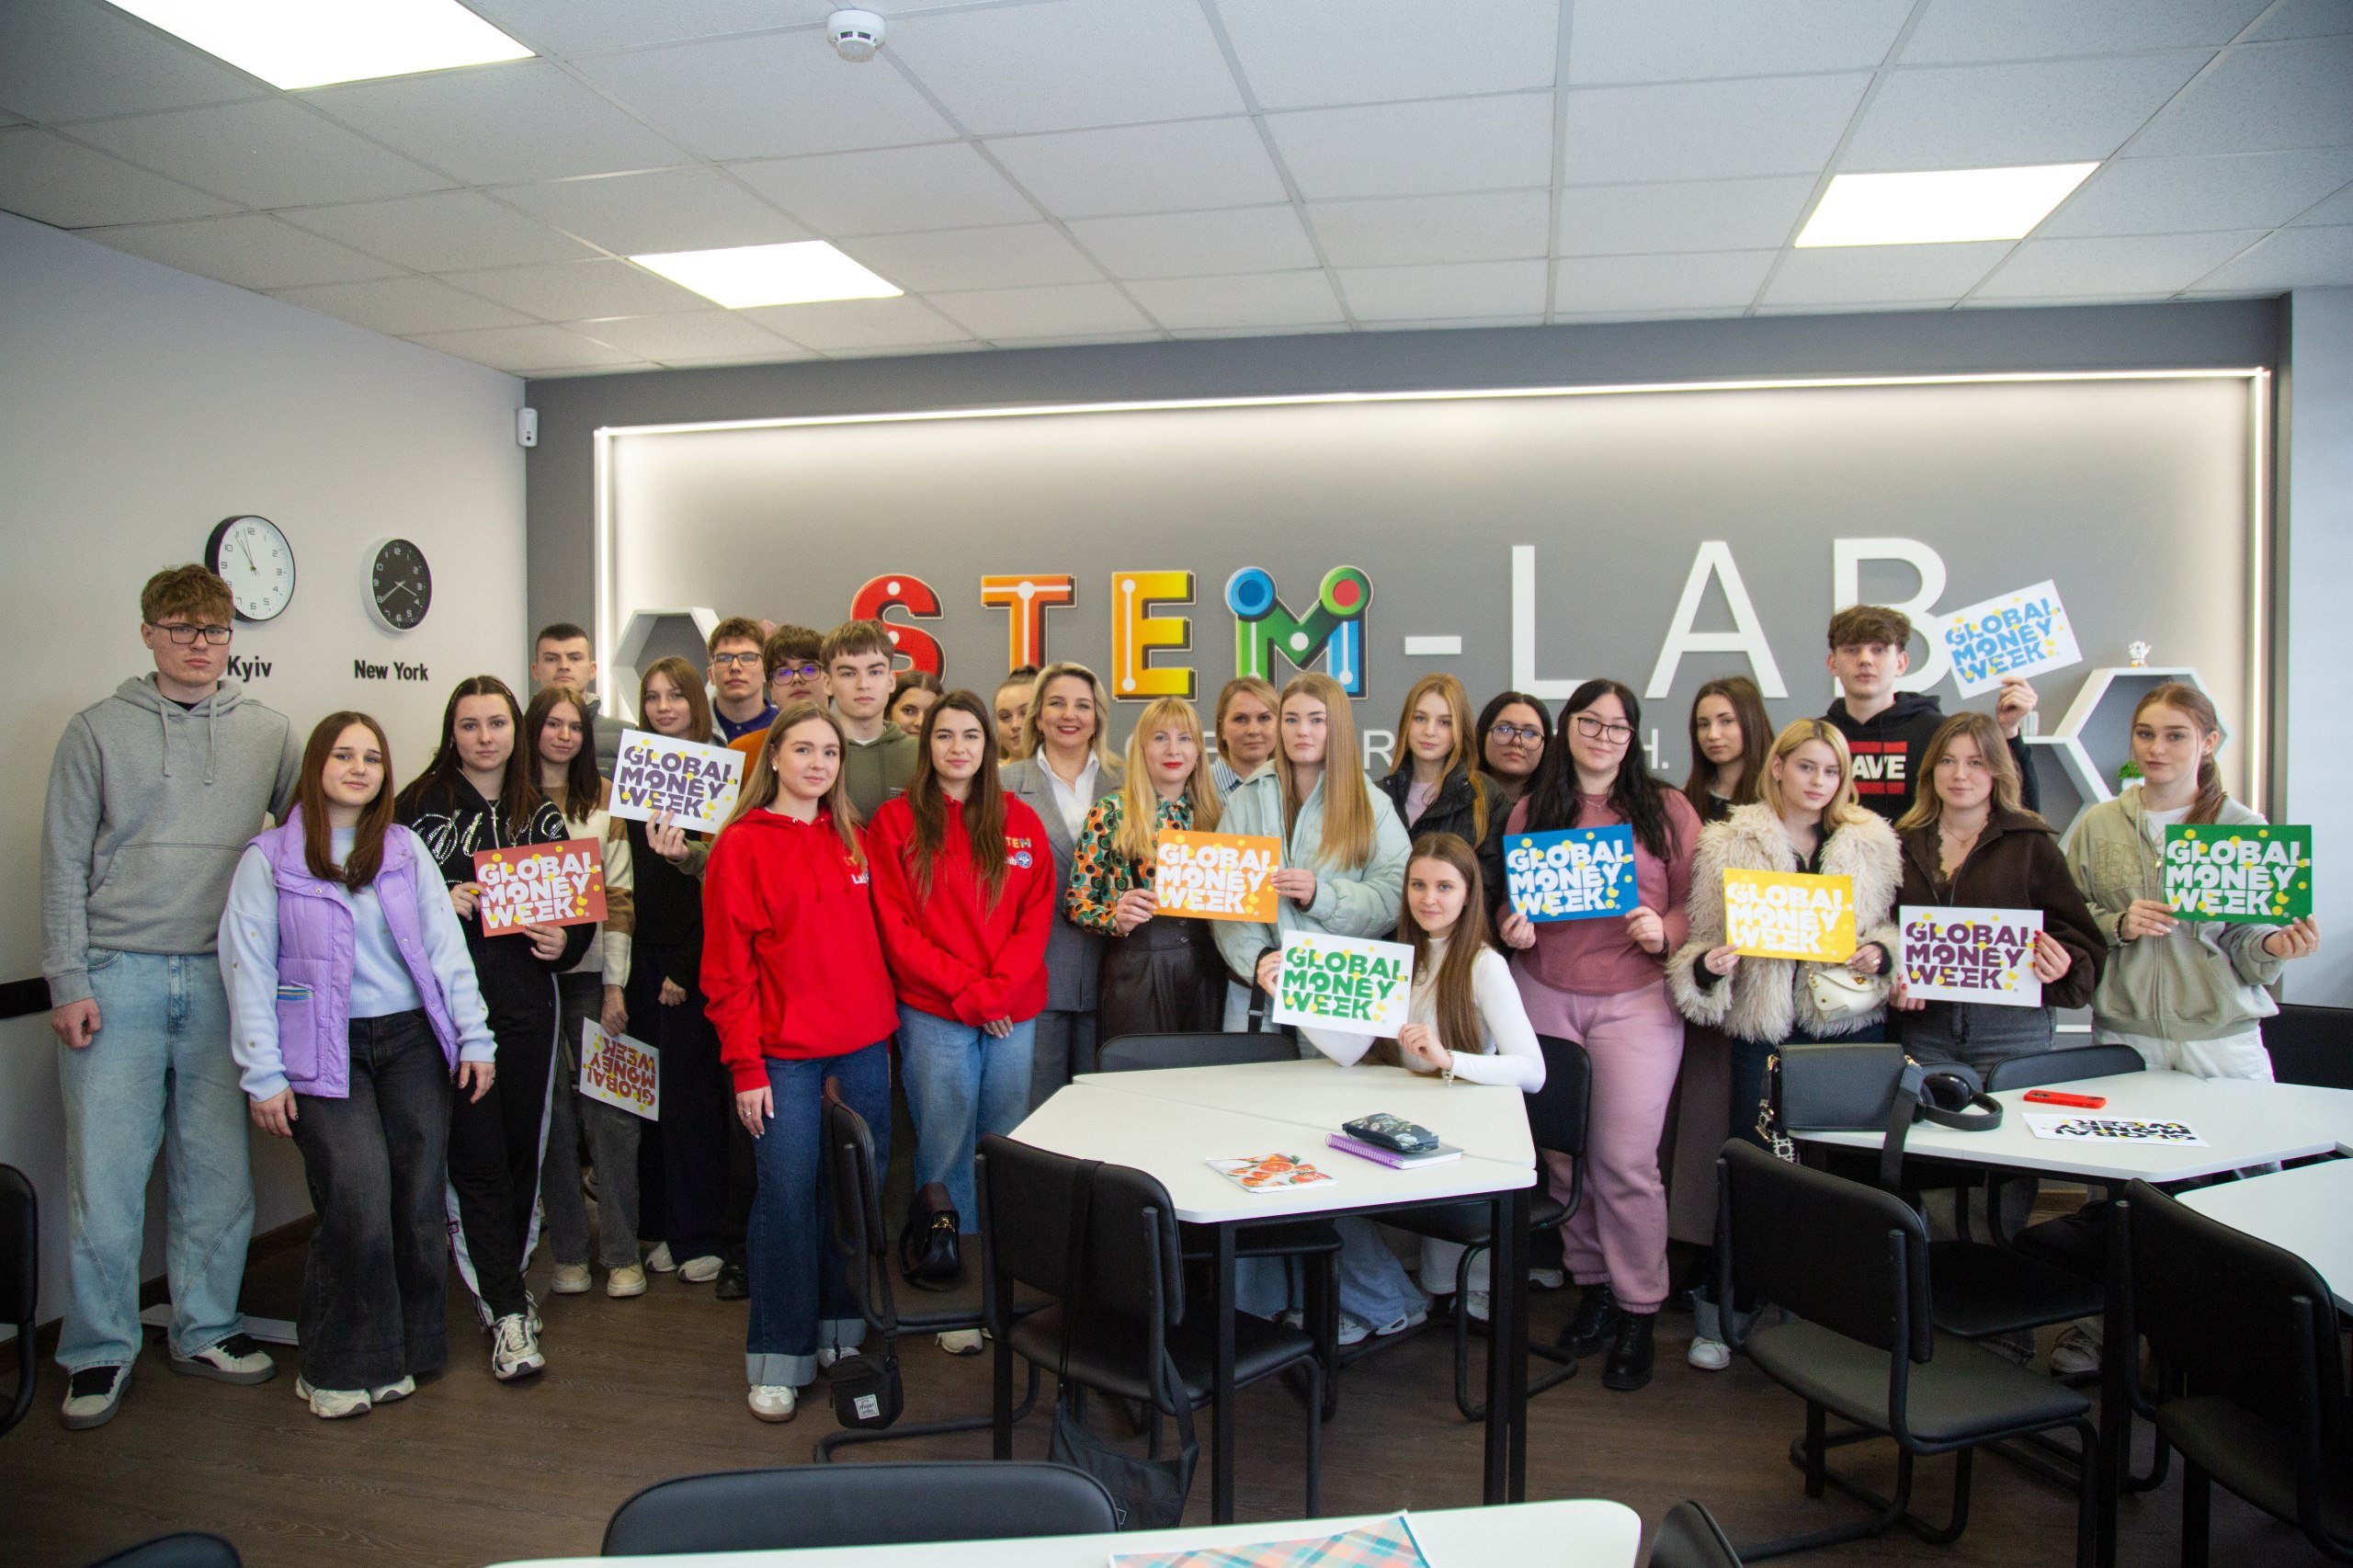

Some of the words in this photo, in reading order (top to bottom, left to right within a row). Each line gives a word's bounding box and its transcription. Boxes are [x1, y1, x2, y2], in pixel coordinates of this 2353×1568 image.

[1945, 597, 2061, 646] GLOBAL
[1950, 617, 2052, 667] MONEY
[227, 655, 272, 682] Kyiv
[354, 659, 388, 679] New
[393, 662, 428, 681] York
[1957, 641, 2047, 684] WEEK
[624, 745, 738, 785] GLOBAL
[1851, 755, 1907, 779] AVE
[620, 766, 726, 801] MONEY
[618, 784, 705, 819] WEEK
[478, 851, 601, 886] GLOBAL
[1158, 843, 1279, 872] GLOBAL
[1506, 839, 1634, 872] GLOBAL
[2166, 839, 2311, 867] GLOBAL
[482, 873, 591, 908] MONEY
[1156, 865, 1267, 893] MONEY
[1508, 862, 1623, 894] MONEY
[2165, 864, 2298, 892] MONEY
[481, 895, 576, 929] WEEK
[1155, 885, 1246, 915] WEEK
[1509, 886, 1607, 915] WEEK
[1726, 881, 1853, 912] GLOBAL
[2165, 888, 2273, 915] WEEK
[1727, 903, 1842, 932] MONEY
[1727, 924, 1823, 954] WEEK
[1286, 947, 1408, 983] GLOBAL
[1905, 944, 2026, 969] MONEY
[1282, 969, 1397, 1000] MONEY
[1905, 963, 2004, 990] WEEK
[1281, 989, 1374, 1021] WEEK
[589, 1051, 656, 1090] MONEY
[602, 1037, 657, 1074] WEEK
